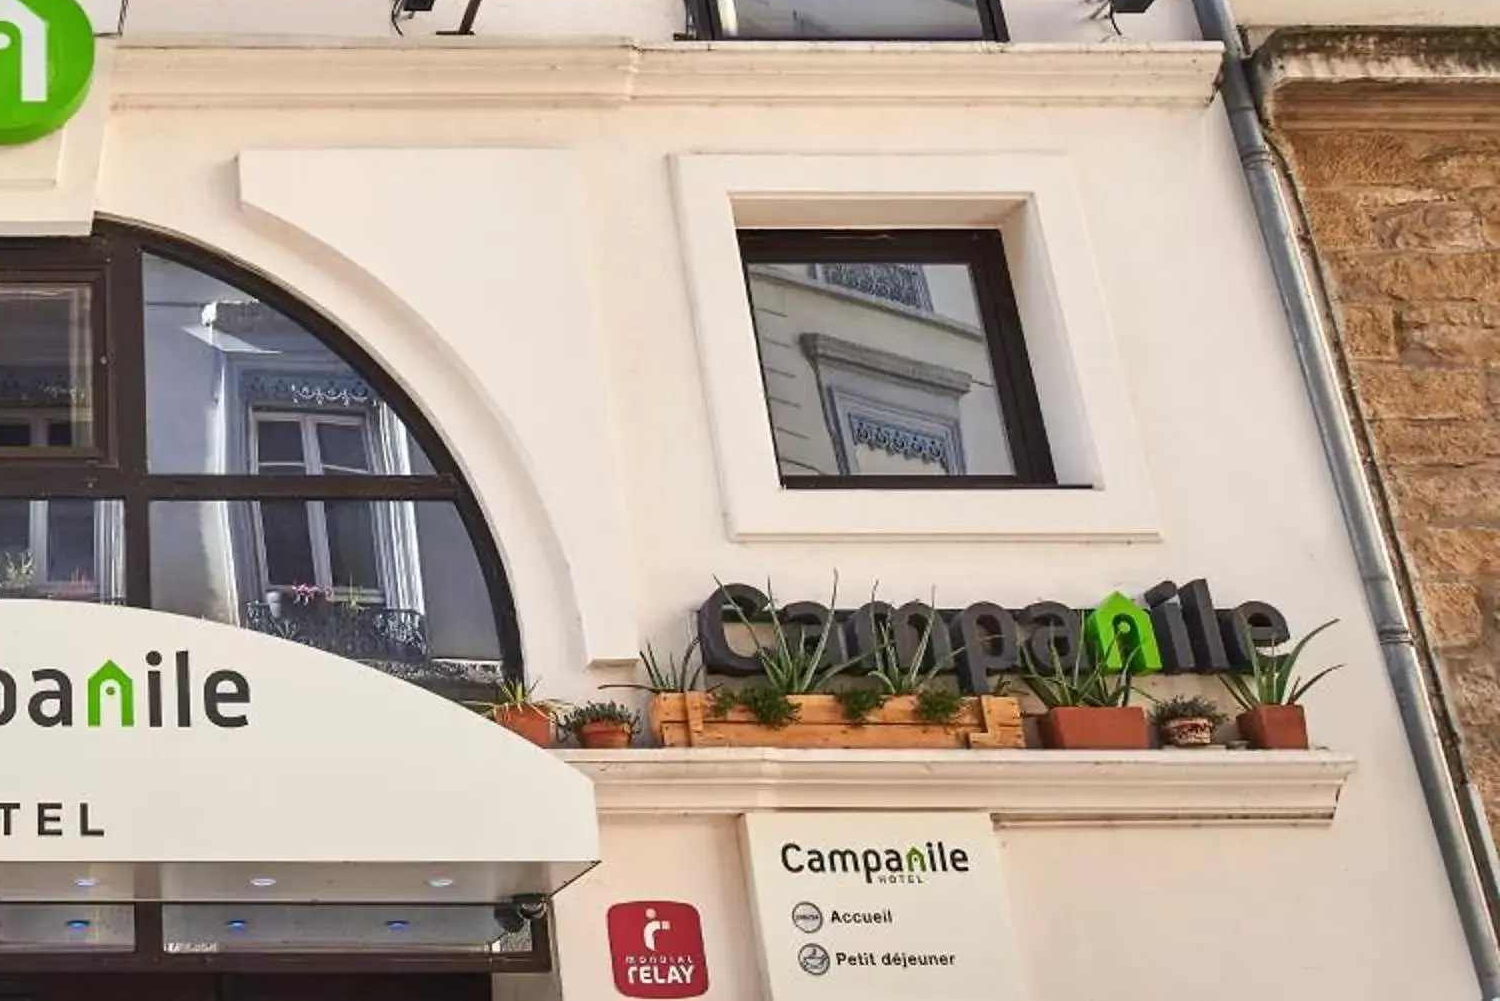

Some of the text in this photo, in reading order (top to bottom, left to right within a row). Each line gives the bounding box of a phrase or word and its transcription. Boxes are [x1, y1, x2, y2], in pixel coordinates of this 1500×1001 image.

[698, 576, 1292, 693] Campanile
[780, 841, 970, 884] Campanile
[877, 874, 924, 884] HOTEL
[830, 909, 893, 924] Accueil
[835, 951, 955, 970] Petit déjeuner
